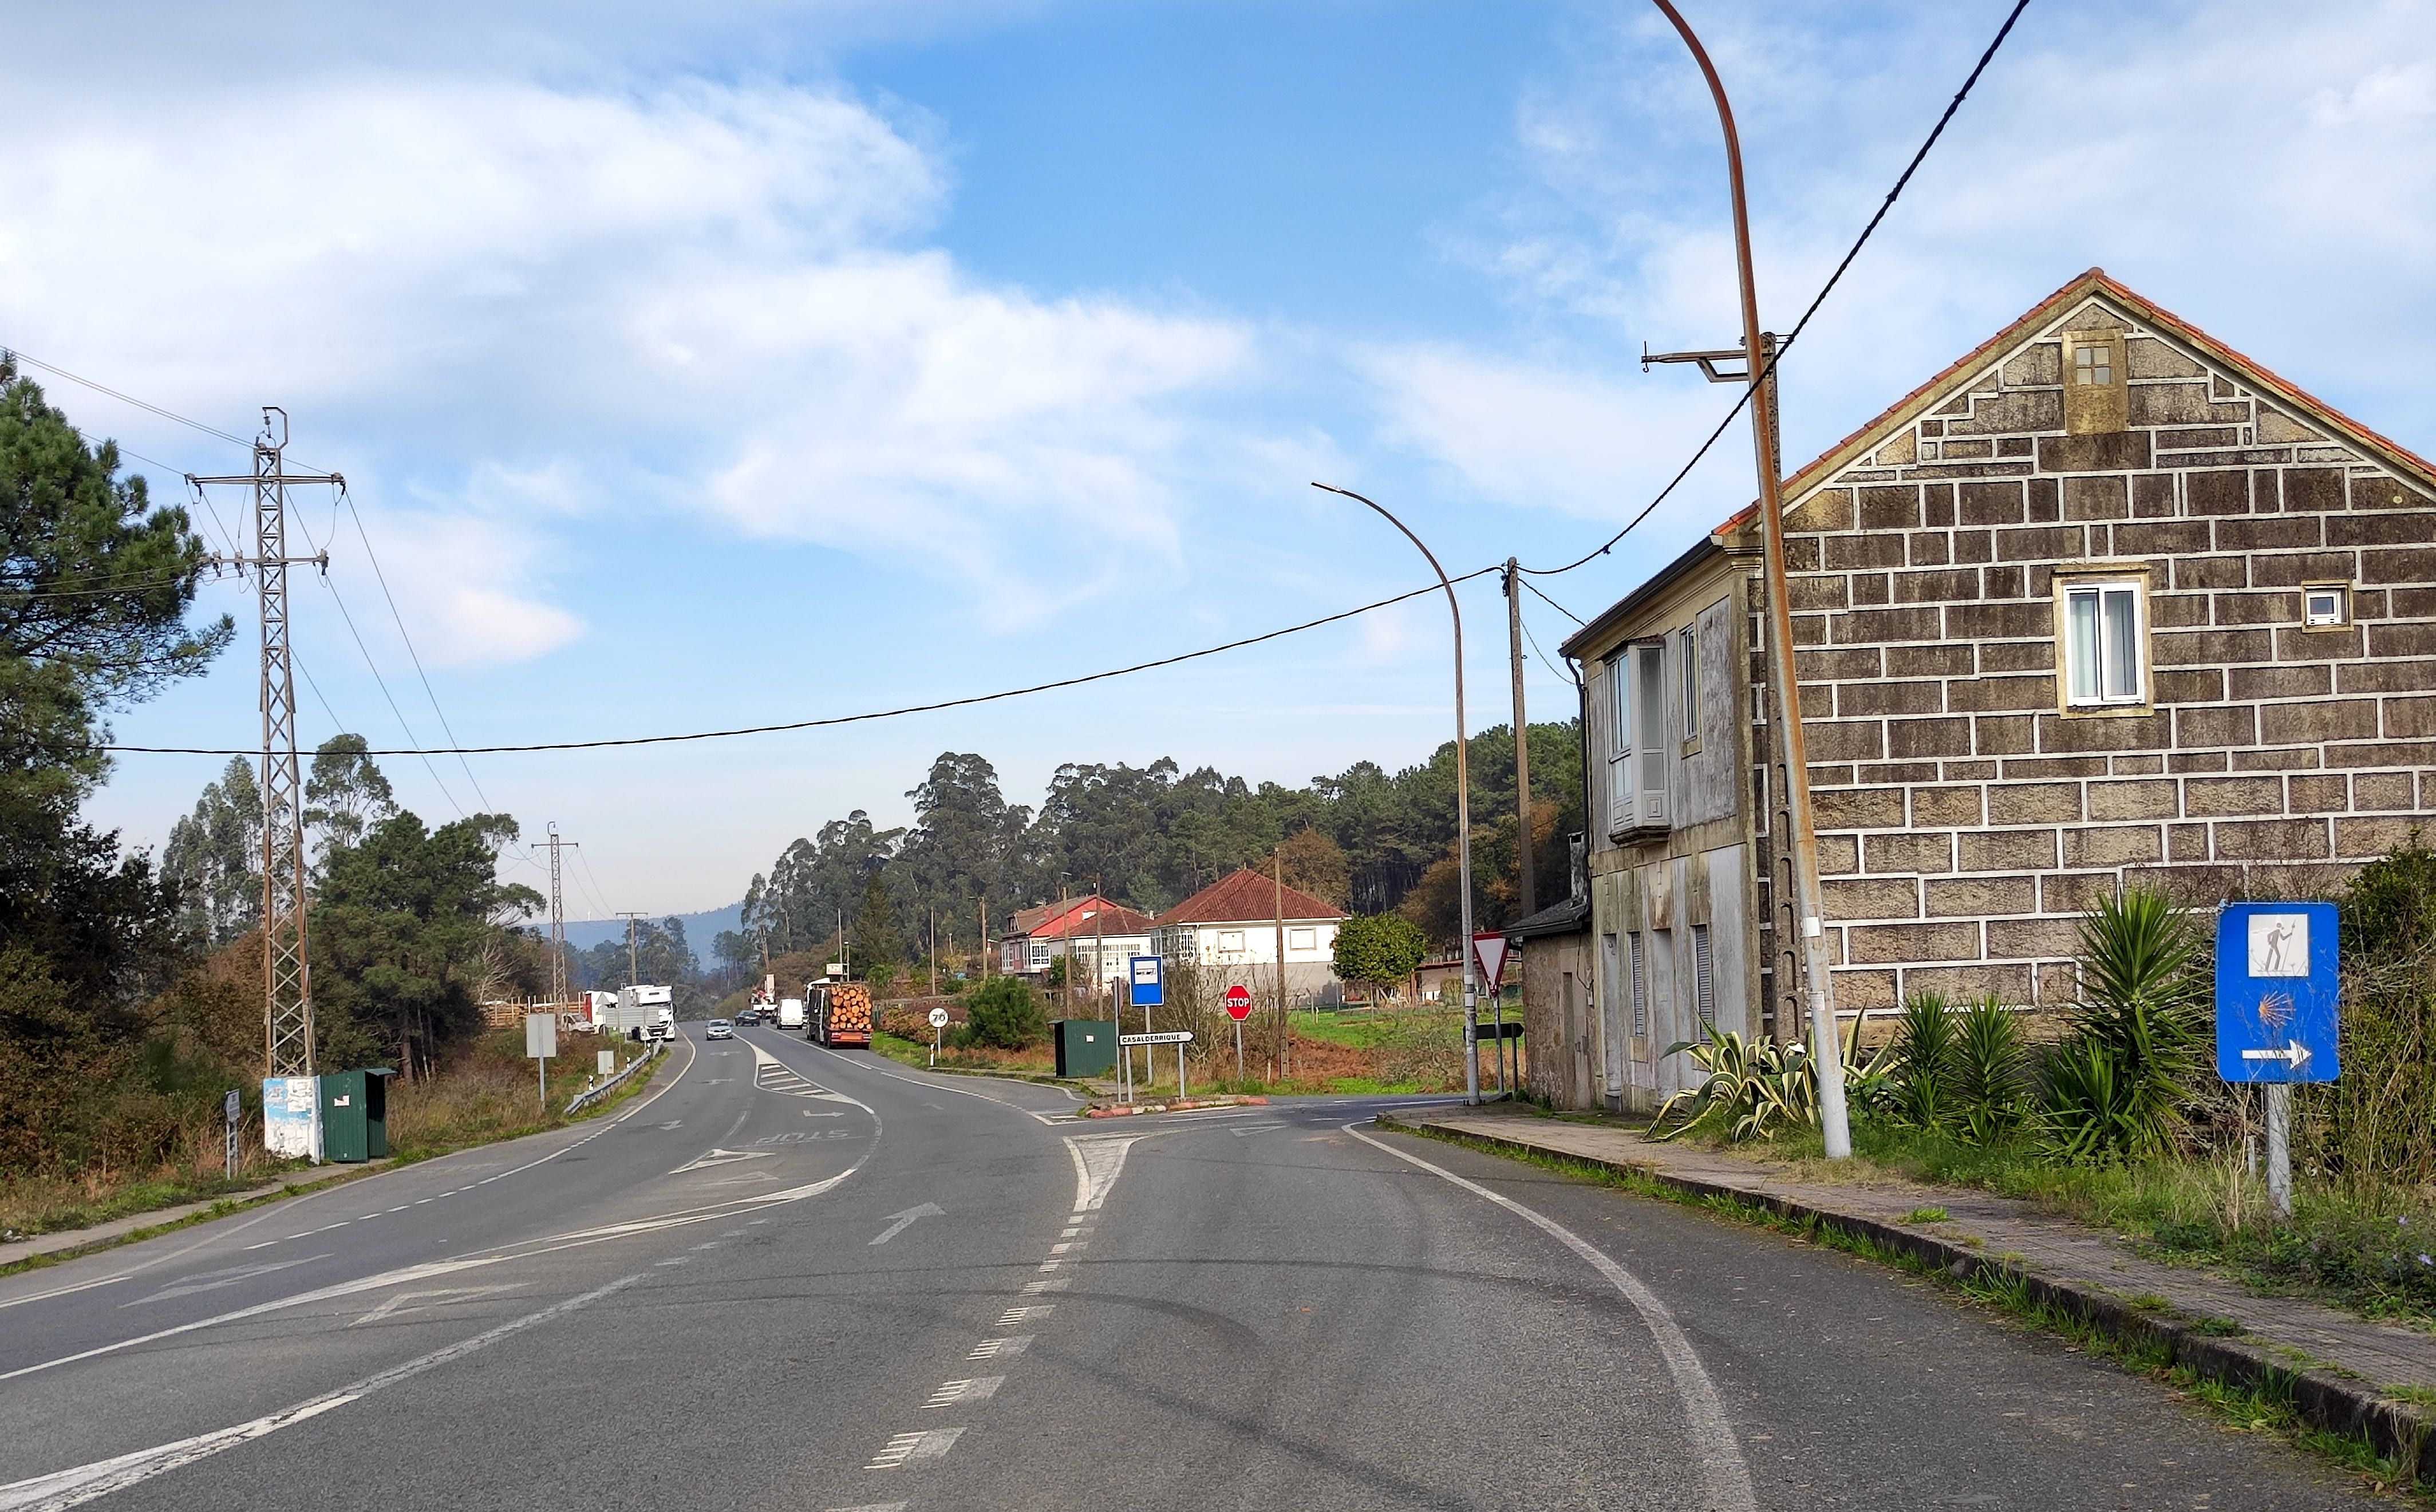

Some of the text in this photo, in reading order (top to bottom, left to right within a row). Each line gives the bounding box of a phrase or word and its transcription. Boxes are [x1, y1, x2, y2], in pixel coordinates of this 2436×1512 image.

[1227, 997, 1250, 1008] STOP
[933, 1013, 945, 1022] 70
[1122, 1034, 1181, 1043] CASALDERRIQUE
